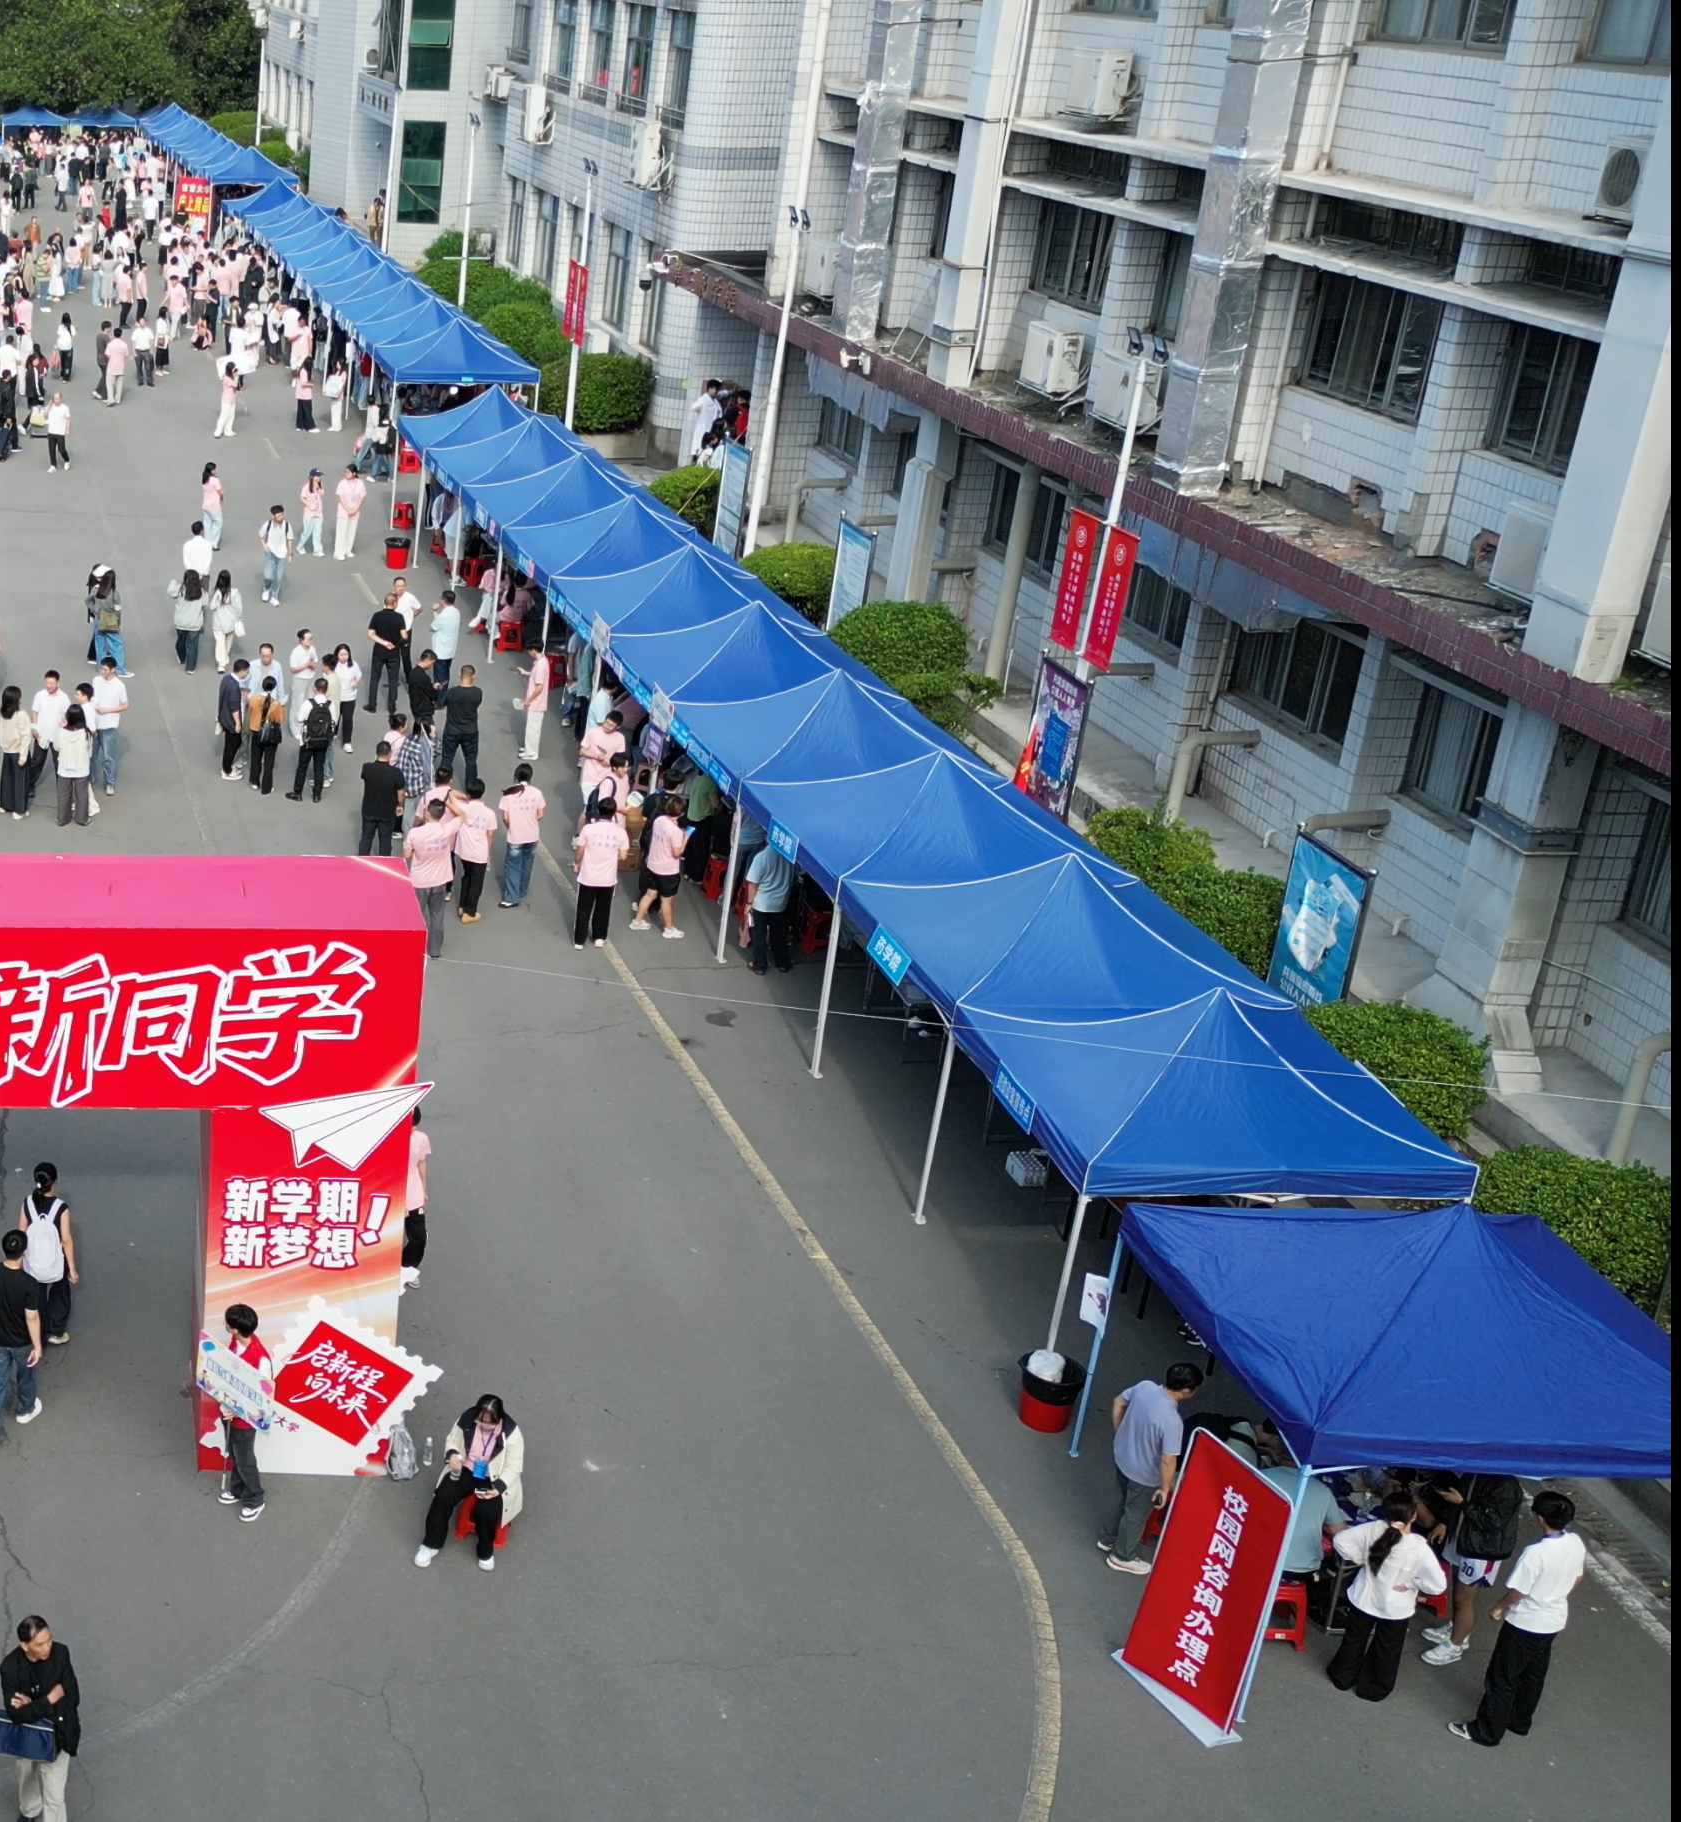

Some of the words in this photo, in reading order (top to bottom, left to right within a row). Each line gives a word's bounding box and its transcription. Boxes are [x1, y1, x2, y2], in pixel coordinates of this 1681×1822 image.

[772, 825, 792, 855] 药学院
[874, 935, 902, 973] 药学院
[223, 1179, 361, 1223] 新学期
[221, 1226, 358, 1269] 新梦想
[282, 1340, 388, 1403] 启新程
[289, 1373, 380, 1434] 向未来
[1167, 1484, 1249, 1688] 校园网咨询办理点
